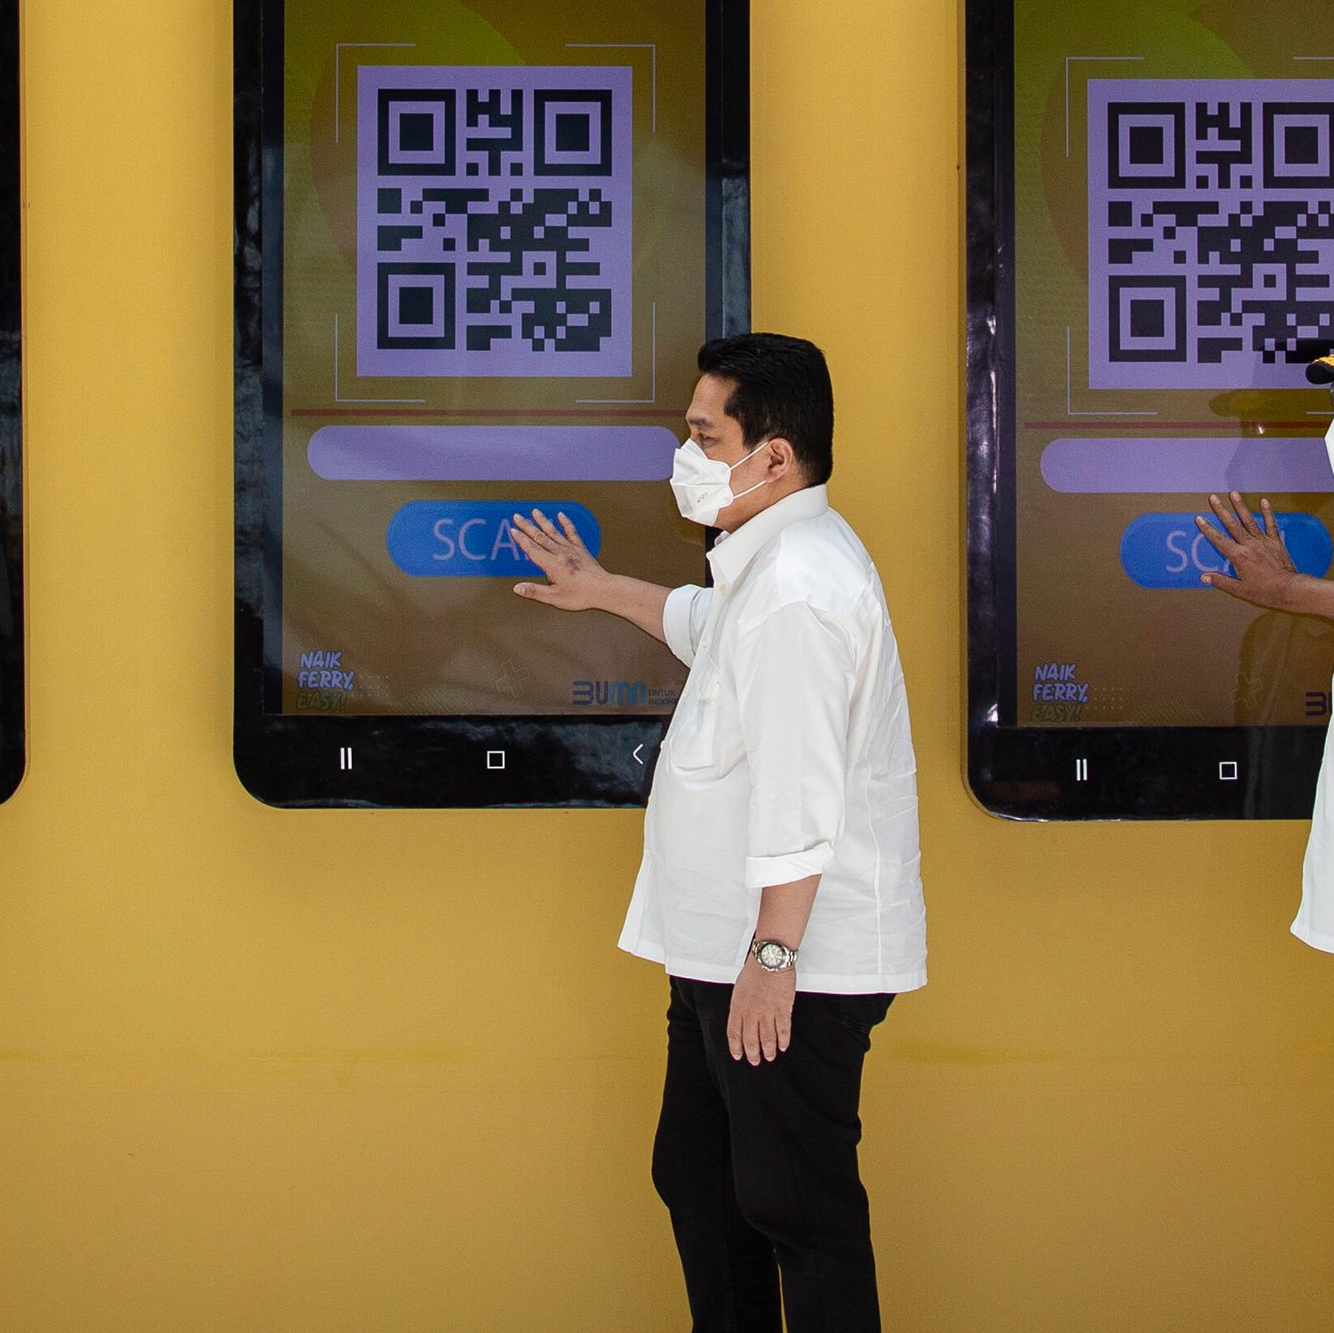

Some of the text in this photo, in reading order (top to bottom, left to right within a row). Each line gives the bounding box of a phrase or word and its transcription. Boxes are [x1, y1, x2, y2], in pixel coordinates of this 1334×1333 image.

[431, 517, 554, 562] SCA
[299, 650, 343, 670] NAIK
[1033, 662, 1077, 682] NAIK
